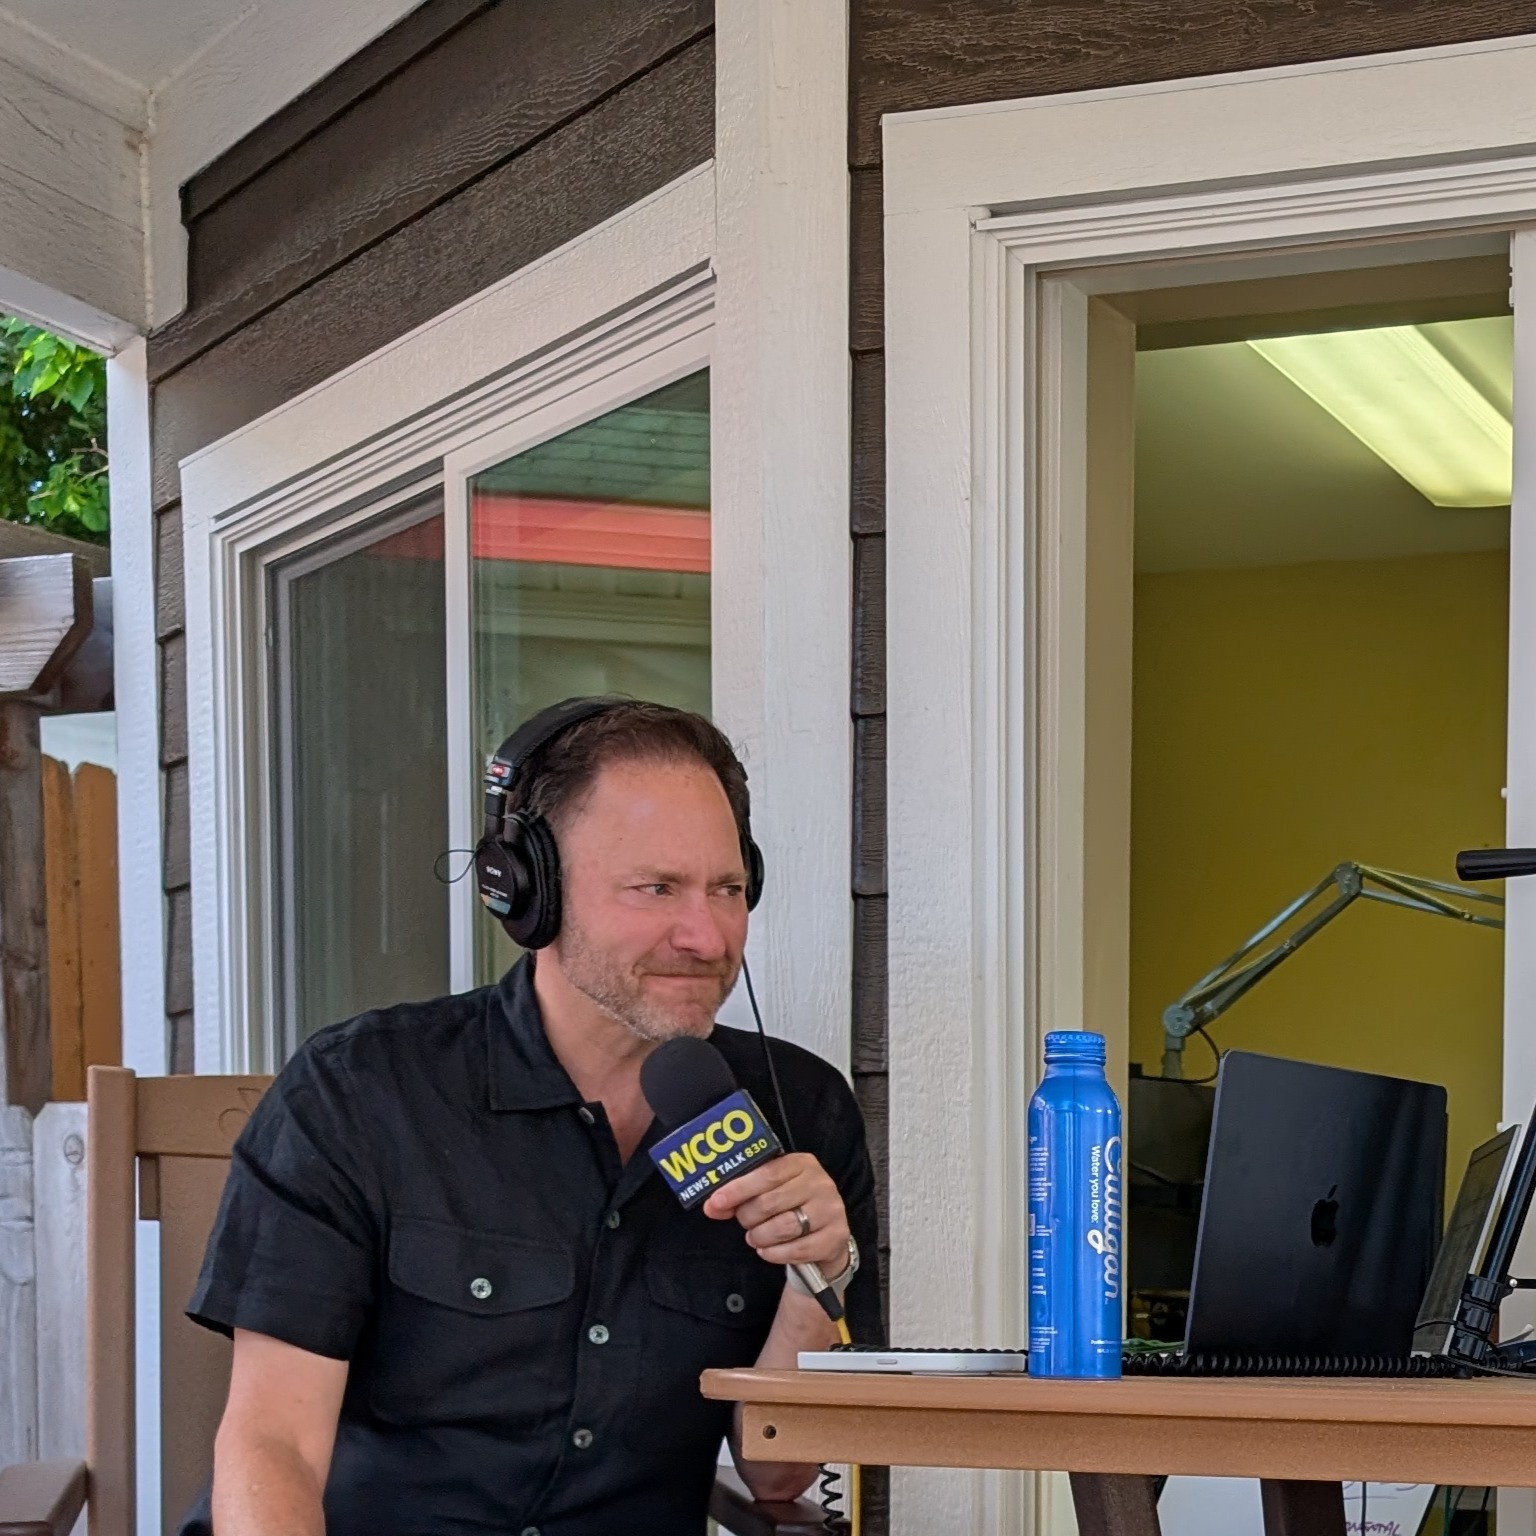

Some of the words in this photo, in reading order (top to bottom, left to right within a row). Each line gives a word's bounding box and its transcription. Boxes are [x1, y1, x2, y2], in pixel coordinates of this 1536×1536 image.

[659, 1110, 754, 1183] WCCO
[1091, 1145, 1101, 1176] Water
[680, 1176, 710, 1201] NEWS
[717, 1152, 746, 1175] TALK
[744, 1139, 767, 1157] 830
[1089, 1179, 1100, 1198] you
